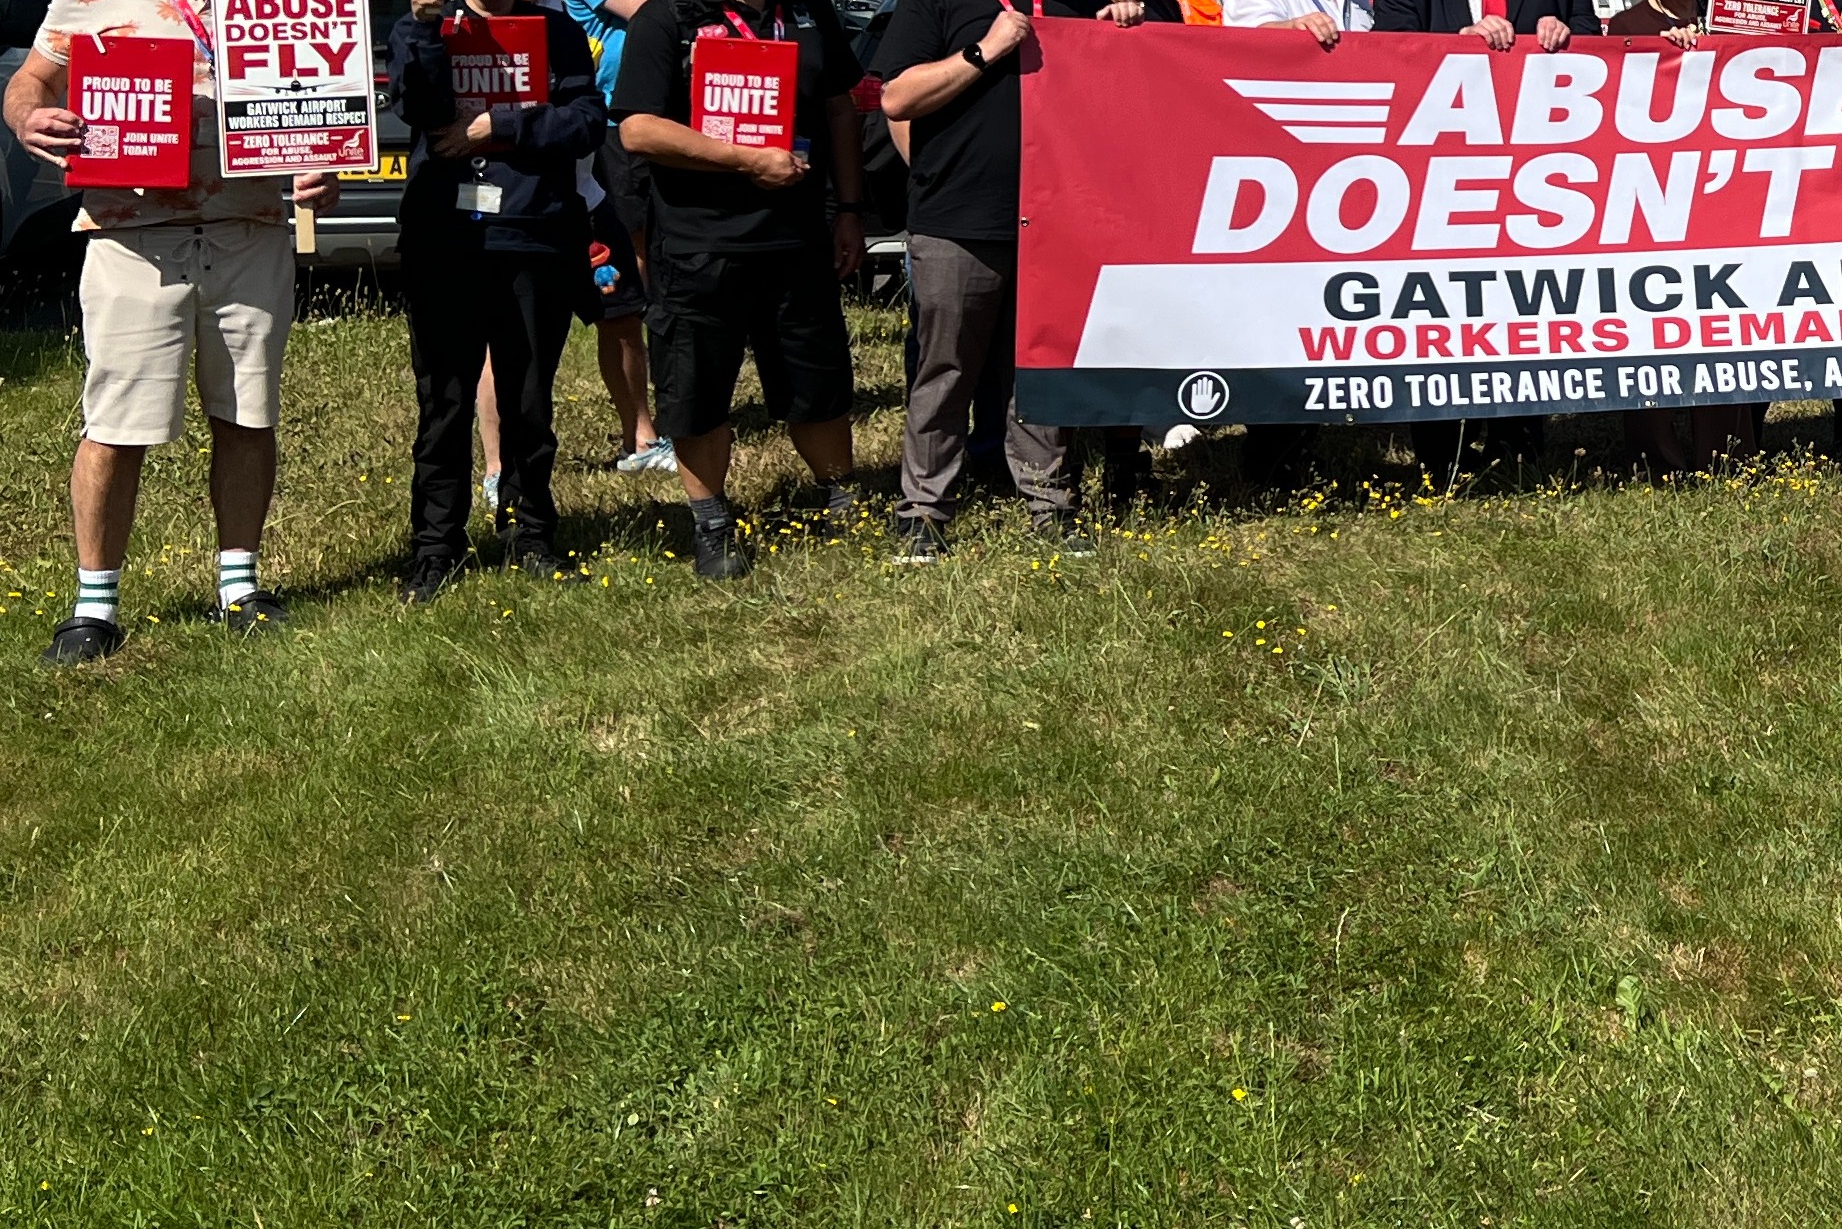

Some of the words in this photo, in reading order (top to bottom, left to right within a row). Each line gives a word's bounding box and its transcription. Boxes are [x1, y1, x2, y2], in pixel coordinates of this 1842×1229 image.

[226, 21, 357, 42] DOESN'T
[227, 42, 357, 80] FLY
[452, 54, 492, 66] PROUD
[496, 54, 510, 66] TO
[513, 52, 530, 66] BE
[82, 76, 130, 91] PROUD
[134, 78, 150, 92] TO
[154, 78, 172, 92] BE
[452, 66, 531, 93] UNITE
[704, 72, 744, 87] PROUD
[746, 74, 762, 88] TO
[764, 76, 780, 89] BE
[82, 92, 172, 122] UNITE
[247, 101, 297, 116] GATWICK
[301, 100, 346, 113] AIRPORT
[704, 86, 779, 116] UNITE
[229, 116, 279, 129] WORKERS
[282, 114, 323, 127] DEMAND
[326, 112, 366, 125] RESPECT
[123, 132, 148, 144] JOIN
[150, 133, 179, 144] UNITE
[244, 135, 270, 149] ZERO
[272, 132, 329, 146] TOLERANCE
[122, 146, 158, 156] TODAY!
[338, 148, 364, 158] unite
[1191, 146, 1836, 254] DOESN'T
[1323, 263, 1748, 321] GATWICK
[1298, 317, 1629, 362] WORKERS
[1304, 375, 1393, 411] ZERO
[1405, 367, 1605, 407] TOLERANCE
[1619, 363, 1683, 397] FOR
[1694, 359, 1813, 394] ABUSE,
